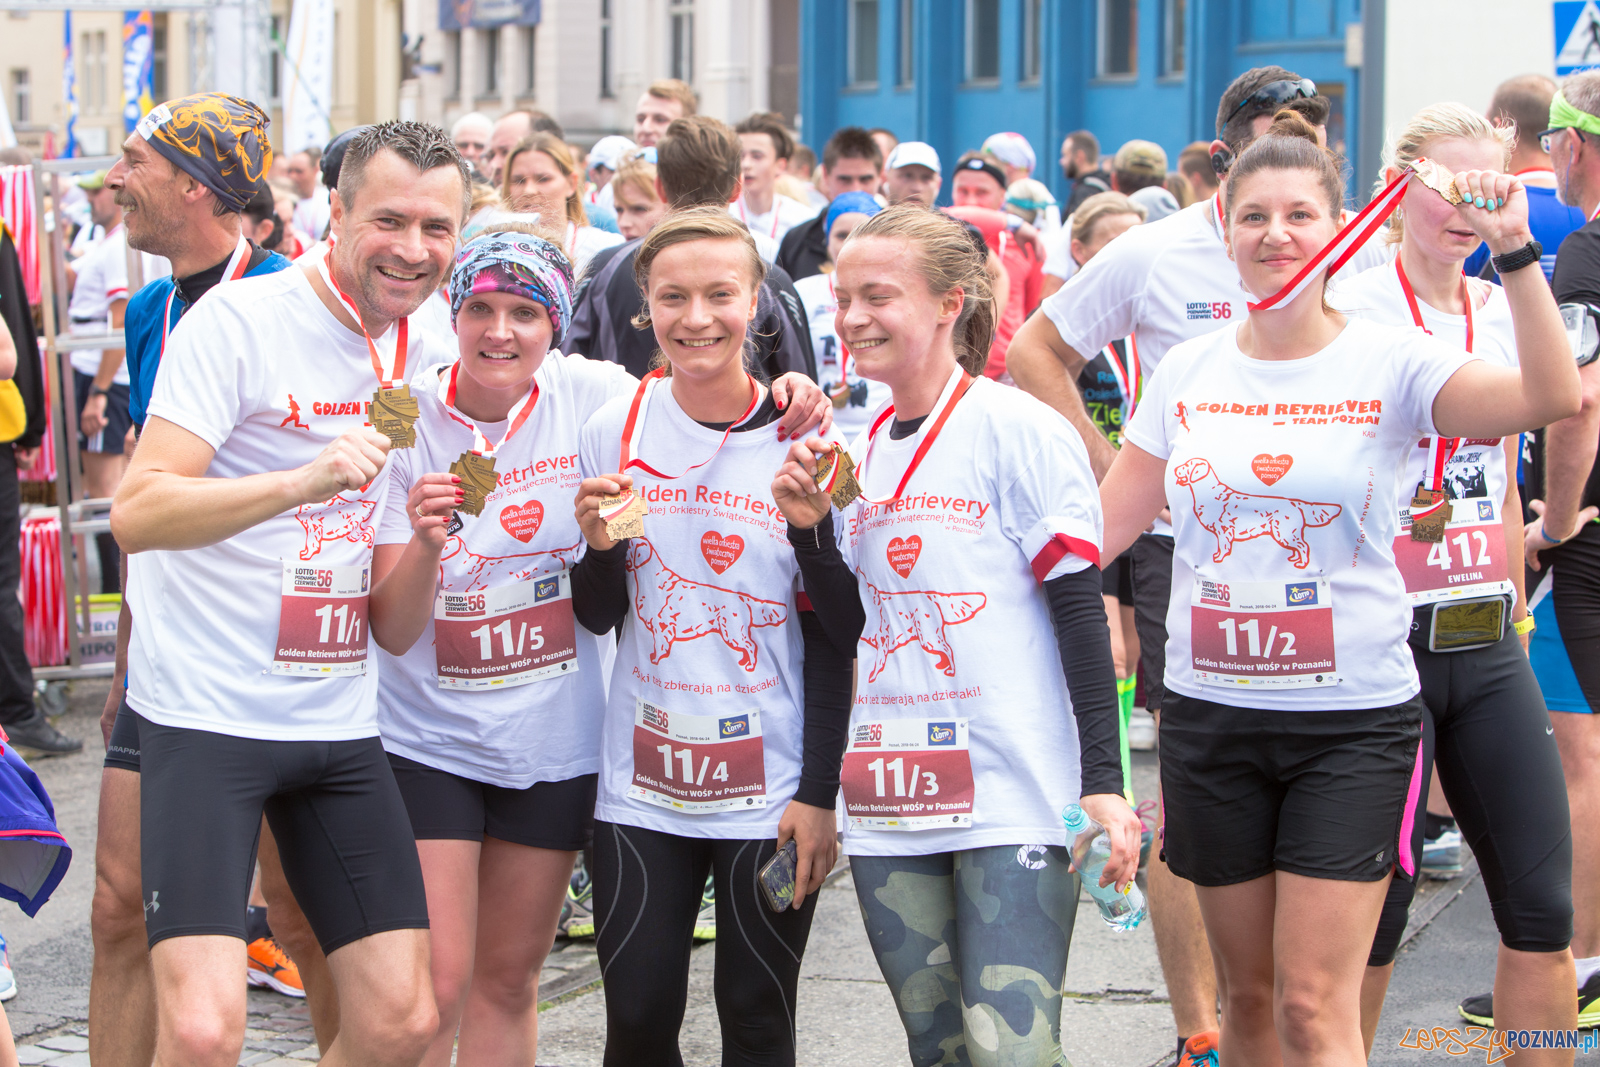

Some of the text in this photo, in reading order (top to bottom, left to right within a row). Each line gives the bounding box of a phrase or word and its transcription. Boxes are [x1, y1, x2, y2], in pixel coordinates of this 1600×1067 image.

[312, 402, 360, 416] GOLDEN
[1195, 399, 1382, 416] GOLDEN RETRIEVER
[1292, 417, 1327, 425] TEAM
[501, 510, 518, 521] wielka
[669, 505, 710, 518] Orkiestry
[712, 507, 770, 530] Świątecznej
[947, 514, 986, 530] Pomocy
[952, 525, 982, 536] Poznaniu
[702, 535, 740, 550] wielka orkiestra
[1426, 530, 1492, 570] 412
[1448, 571, 1483, 584] EWELINA
[315, 604, 361, 645] 11/1
[470, 619, 545, 661] 11/5
[1218, 617, 1297, 658] 11/2
[279, 648, 306, 657] Golden
[307, 650, 338, 658] Retriever
[440, 665, 469, 675] Golden
[471, 663, 509, 675] Retriever
[510, 658, 532, 669] WOŚP
[533, 656, 540, 664] w
[541, 647, 574, 661] Poznaniu
[1195, 657, 1218, 668] Golden
[1219, 661, 1254, 671] Retriever
[1255, 661, 1280, 671] WOŚP
[1292, 658, 1332, 670] Poznaniu
[664, 680, 713, 695] zbierają
[717, 684, 731, 692] na
[881, 694, 915, 706] zbierają
[917, 695, 930, 703] na
[656, 743, 729, 786] 11/4
[636, 773, 658, 787] Golden
[659, 781, 688, 797] Retriever
[689, 787, 713, 798] WOŚP
[724, 782, 762, 795] Poznaniu
[867, 757, 939, 799] 11/3
[848, 804, 870, 812] Golden
[870, 804, 900, 812] Retriever
[902, 801, 925, 812] WOŚP
[935, 801, 971, 811] Poznaniu
